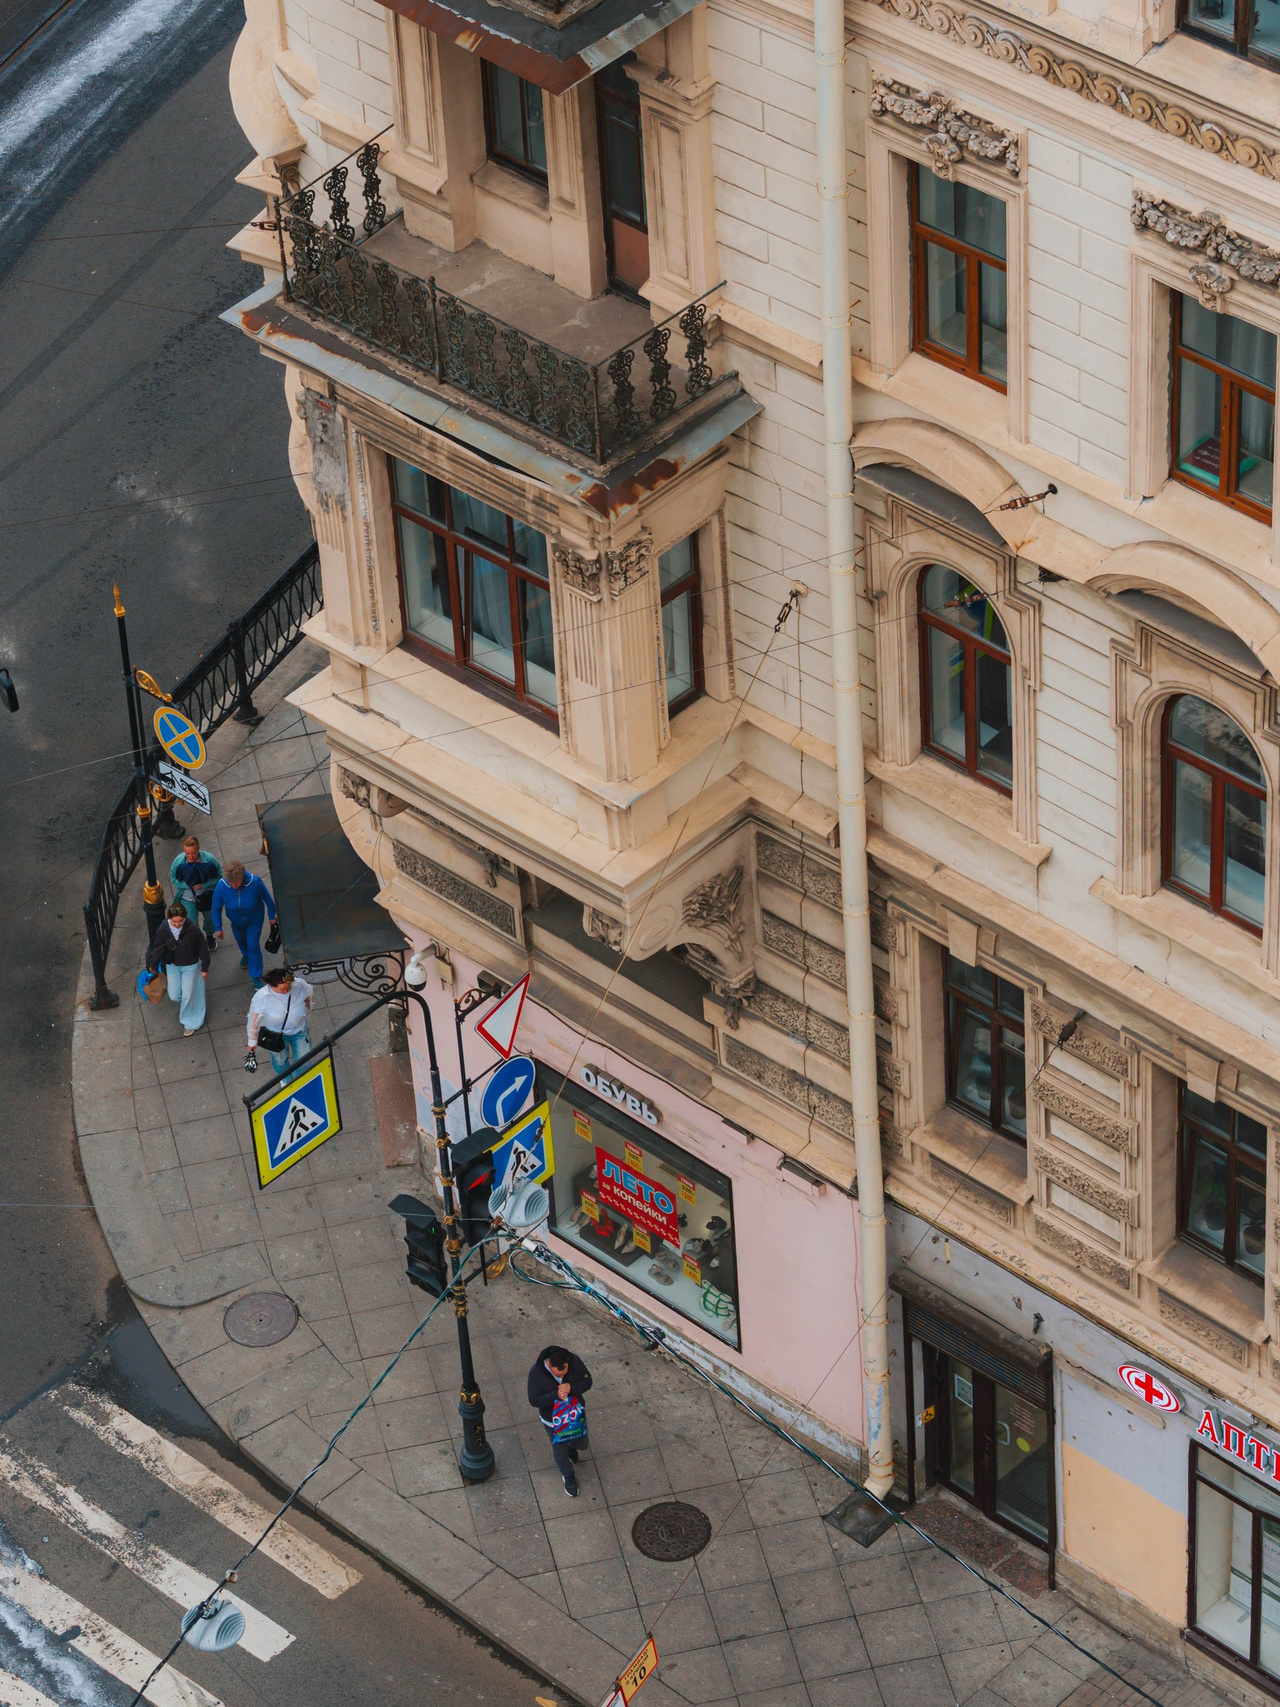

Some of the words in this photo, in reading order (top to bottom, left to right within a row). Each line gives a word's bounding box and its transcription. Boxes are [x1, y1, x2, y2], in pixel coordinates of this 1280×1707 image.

[580, 1067, 658, 1125] ОБУВЬ
[602, 1158, 674, 1214] ЛЕТО
[602, 1181, 611, 1191] за
[613, 1185, 667, 1225] копейки
[632, 1666, 646, 1687] 10
